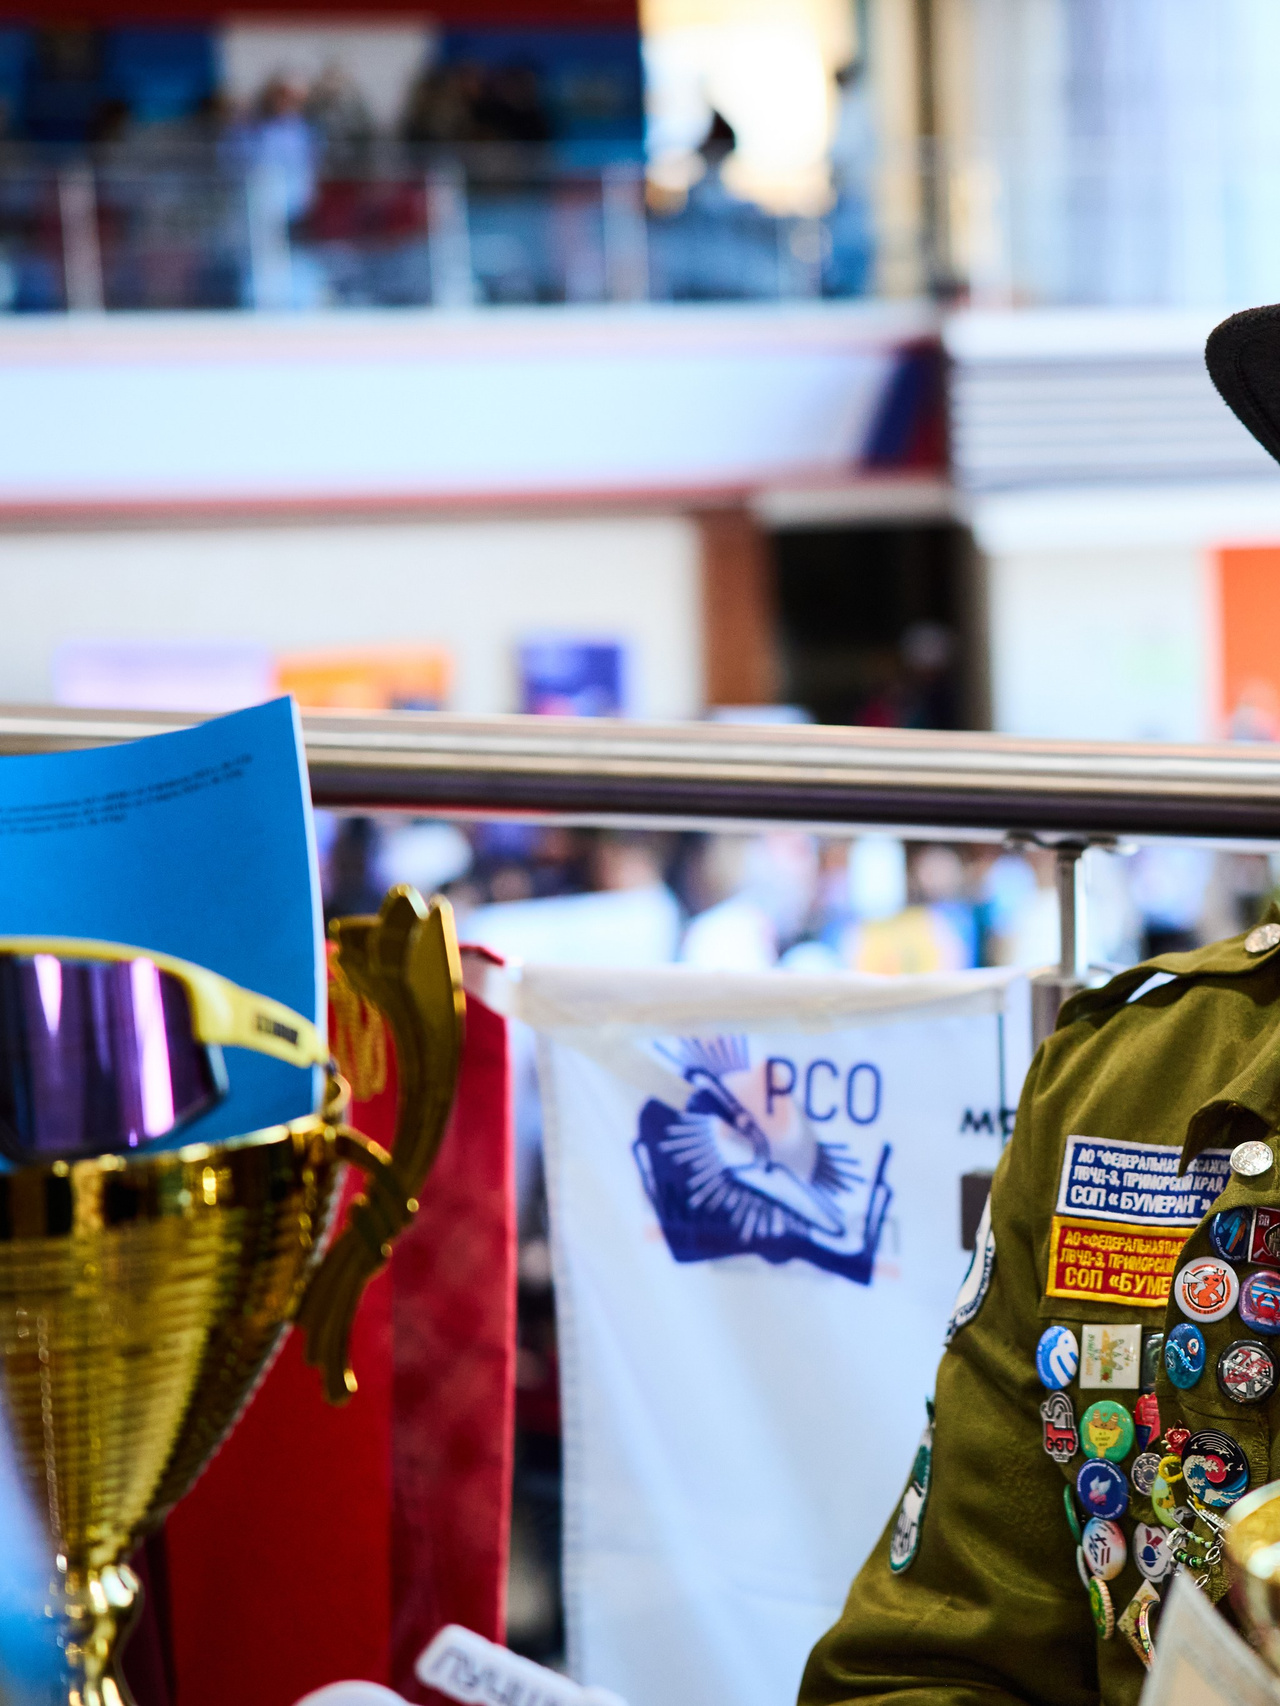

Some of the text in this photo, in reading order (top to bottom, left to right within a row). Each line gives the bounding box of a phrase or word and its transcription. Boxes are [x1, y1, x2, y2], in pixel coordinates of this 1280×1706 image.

[765, 1057, 881, 1126] РСО
[1078, 1148, 1094, 1163] АО
[1123, 1172, 1194, 1191] ПРИМОРСКИЙ
[1070, 1185, 1106, 1207] СОП
[1064, 1267, 1104, 1290] СОП
